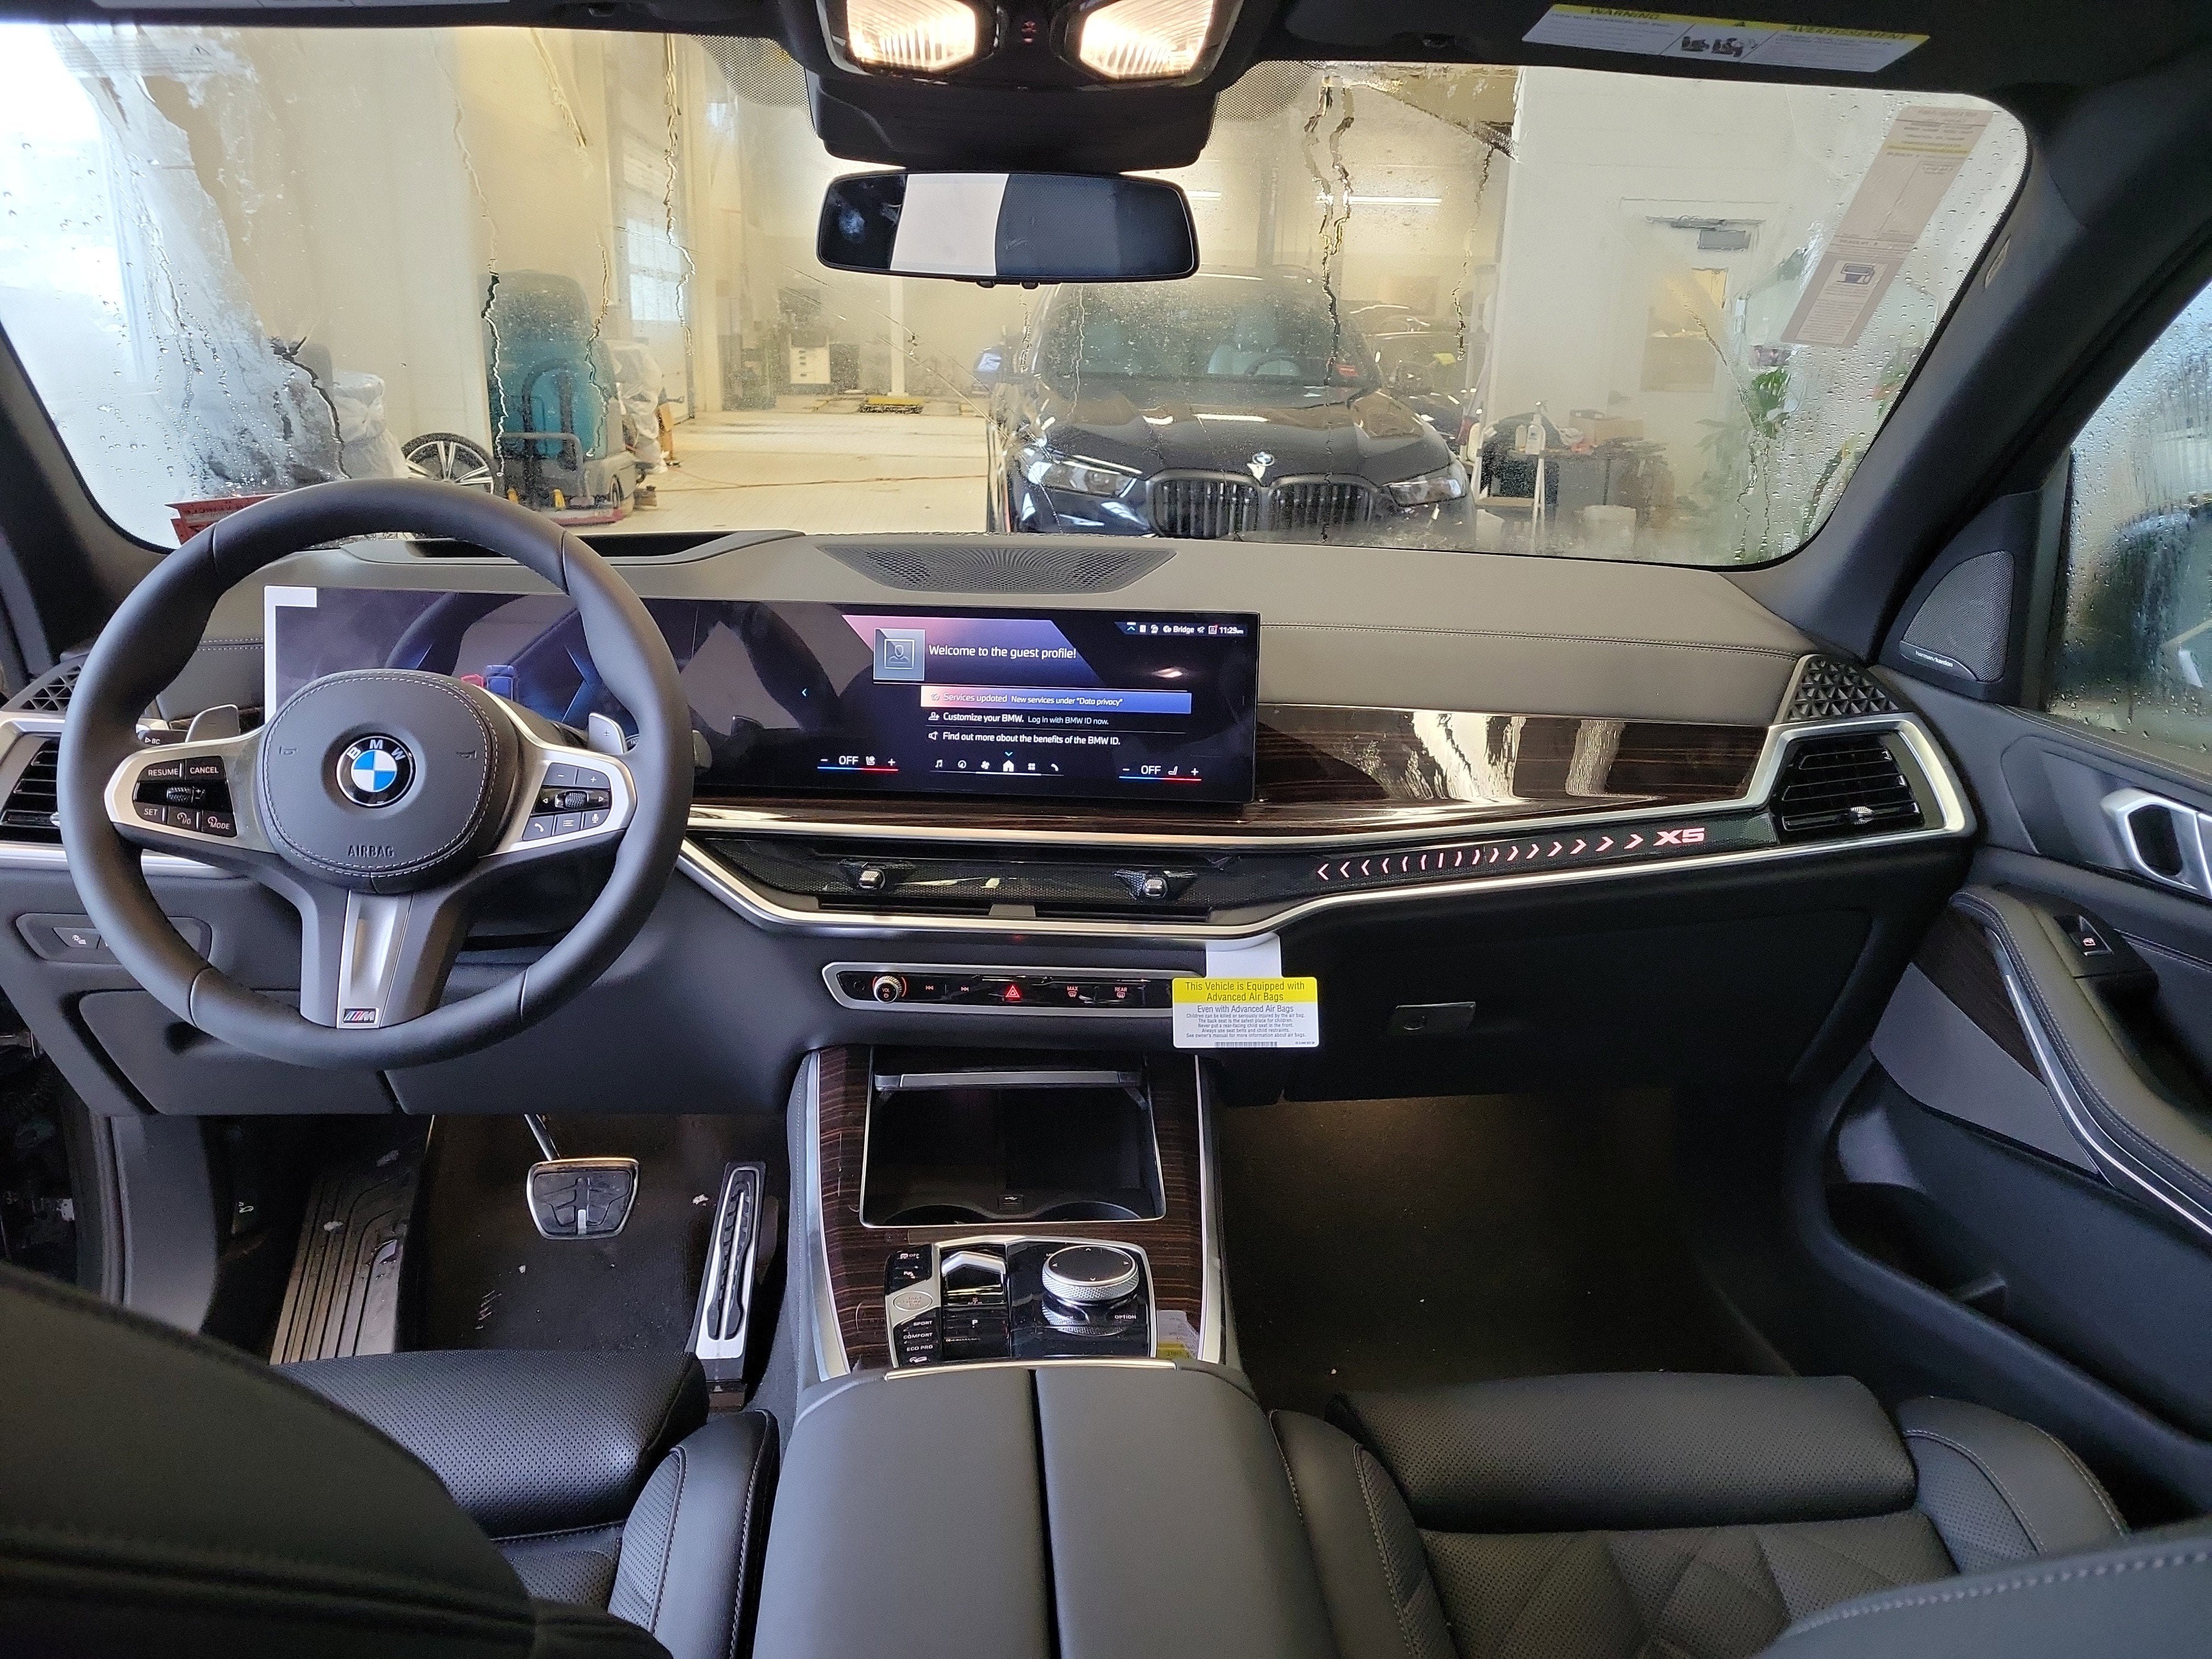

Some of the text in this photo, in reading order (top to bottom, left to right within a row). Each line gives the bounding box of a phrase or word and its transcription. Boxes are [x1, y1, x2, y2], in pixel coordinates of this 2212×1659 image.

[1173, 626, 1194, 635] Bridge
[929, 644, 1076, 660] Welcome to the guest profile!
[944, 693, 975, 702] Services
[977, 695, 1008, 703] updated
[1027, 696, 1054, 704] services
[943, 712, 982, 722] Customize
[983, 715, 1001, 723] your
[1001, 714, 1024, 723] BMW.
[1028, 715, 1041, 724] Log
[1065, 716, 1084, 725] BMW
[943, 731, 960, 740] Find
[996, 734, 1018, 742] about
[1019, 734, 1032, 743] the
[1033, 734, 1063, 744] benefits
[1064, 735, 1073, 744] of
[1088, 736, 1109, 744] BMW
[346, 739, 406, 761] BMW
[838, 755, 859, 765] OFF
[148, 768, 179, 776] RESUME
[1141, 765, 1161, 775] OFF
[1652, 827, 1705, 846] X5
[348, 845, 394, 858] AIRBAG
[1186, 981, 1305, 992] This Vehicle is Equipped with
[1207, 992, 1283, 1002] Advanced Air Bags
[1231, 1005, 1263, 1013] Advanced
[1277, 1005, 1294, 1014] Bags
